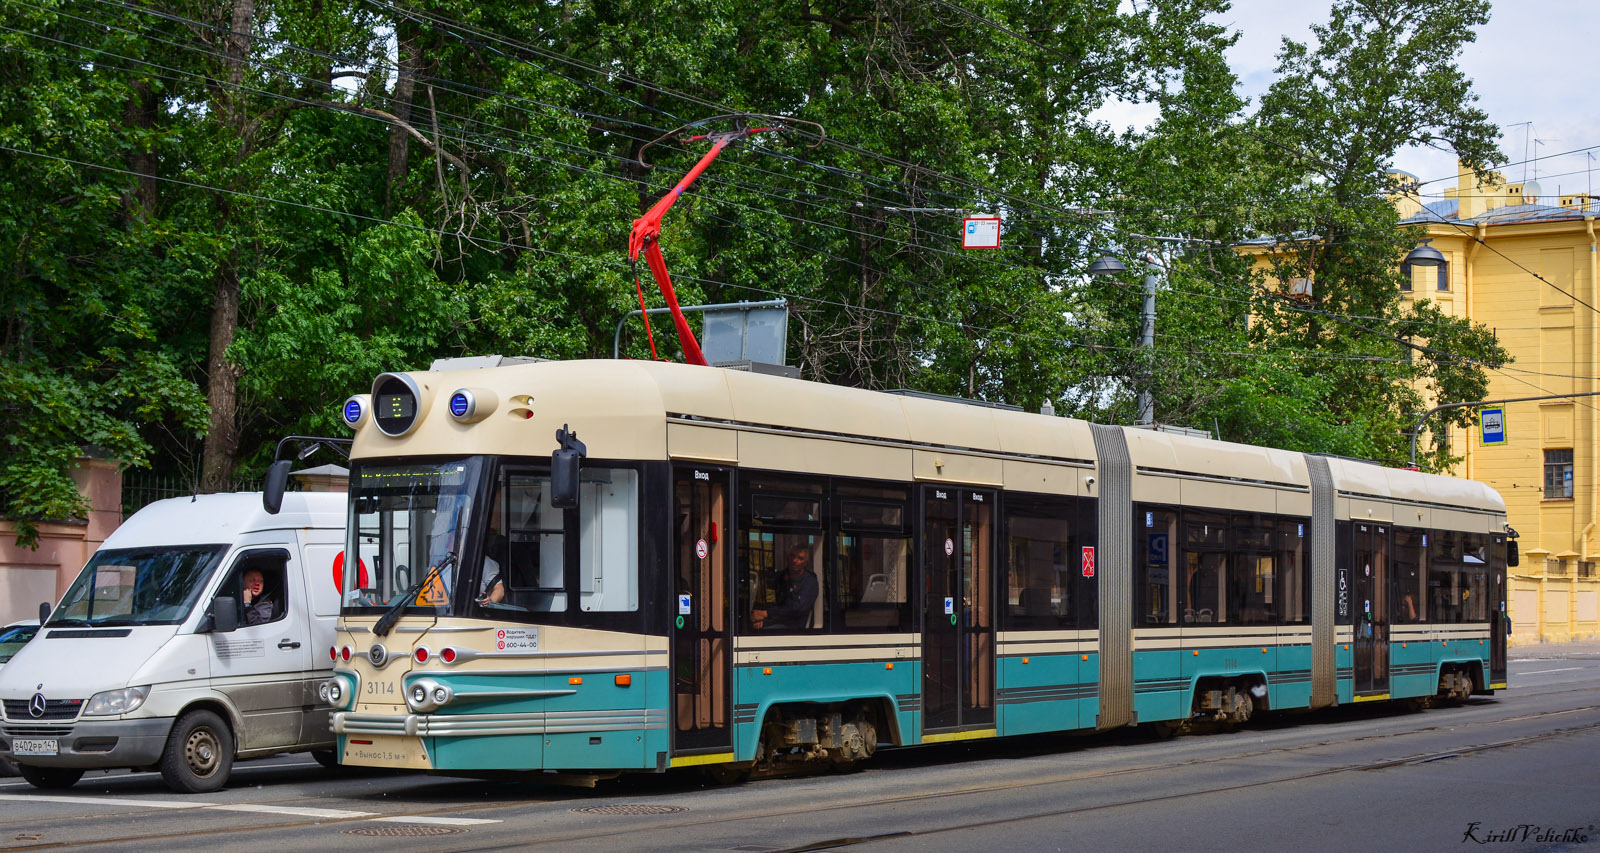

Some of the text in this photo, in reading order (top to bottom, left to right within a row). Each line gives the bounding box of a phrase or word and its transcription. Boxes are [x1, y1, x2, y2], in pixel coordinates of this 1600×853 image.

[694, 469, 709, 481] Вход
[936, 490, 947, 500] Вход
[972, 492, 983, 502] Вход
[367, 681, 394, 695] 3114
[44, 740, 56, 749] 147
[359, 750, 382, 759] Вынос
[383, 751, 393, 760] 1,5
